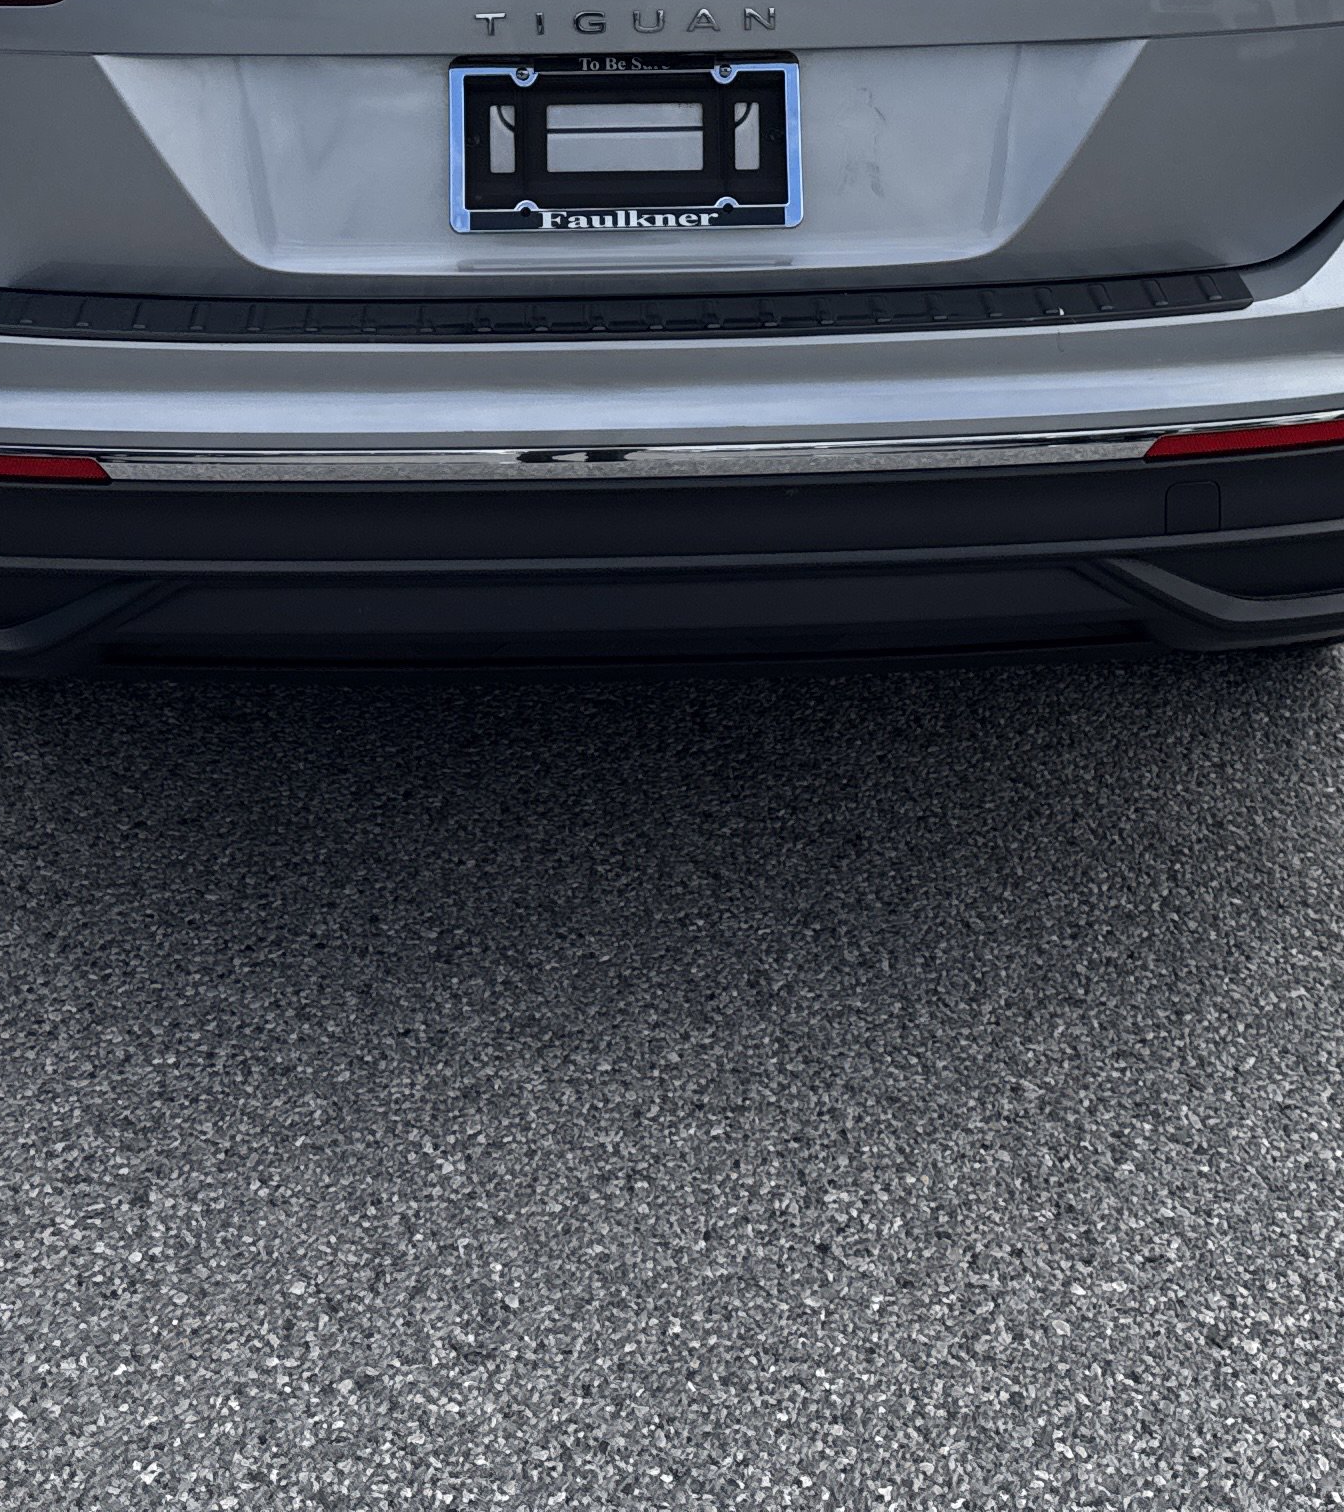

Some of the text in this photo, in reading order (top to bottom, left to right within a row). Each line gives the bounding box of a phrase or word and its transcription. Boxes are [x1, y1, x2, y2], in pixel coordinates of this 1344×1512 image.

[474, 7, 776, 37] TIGUAN
[578, 57, 600, 71] To
[605, 57, 627, 71] Be
[538, 210, 719, 229] Faulkner
